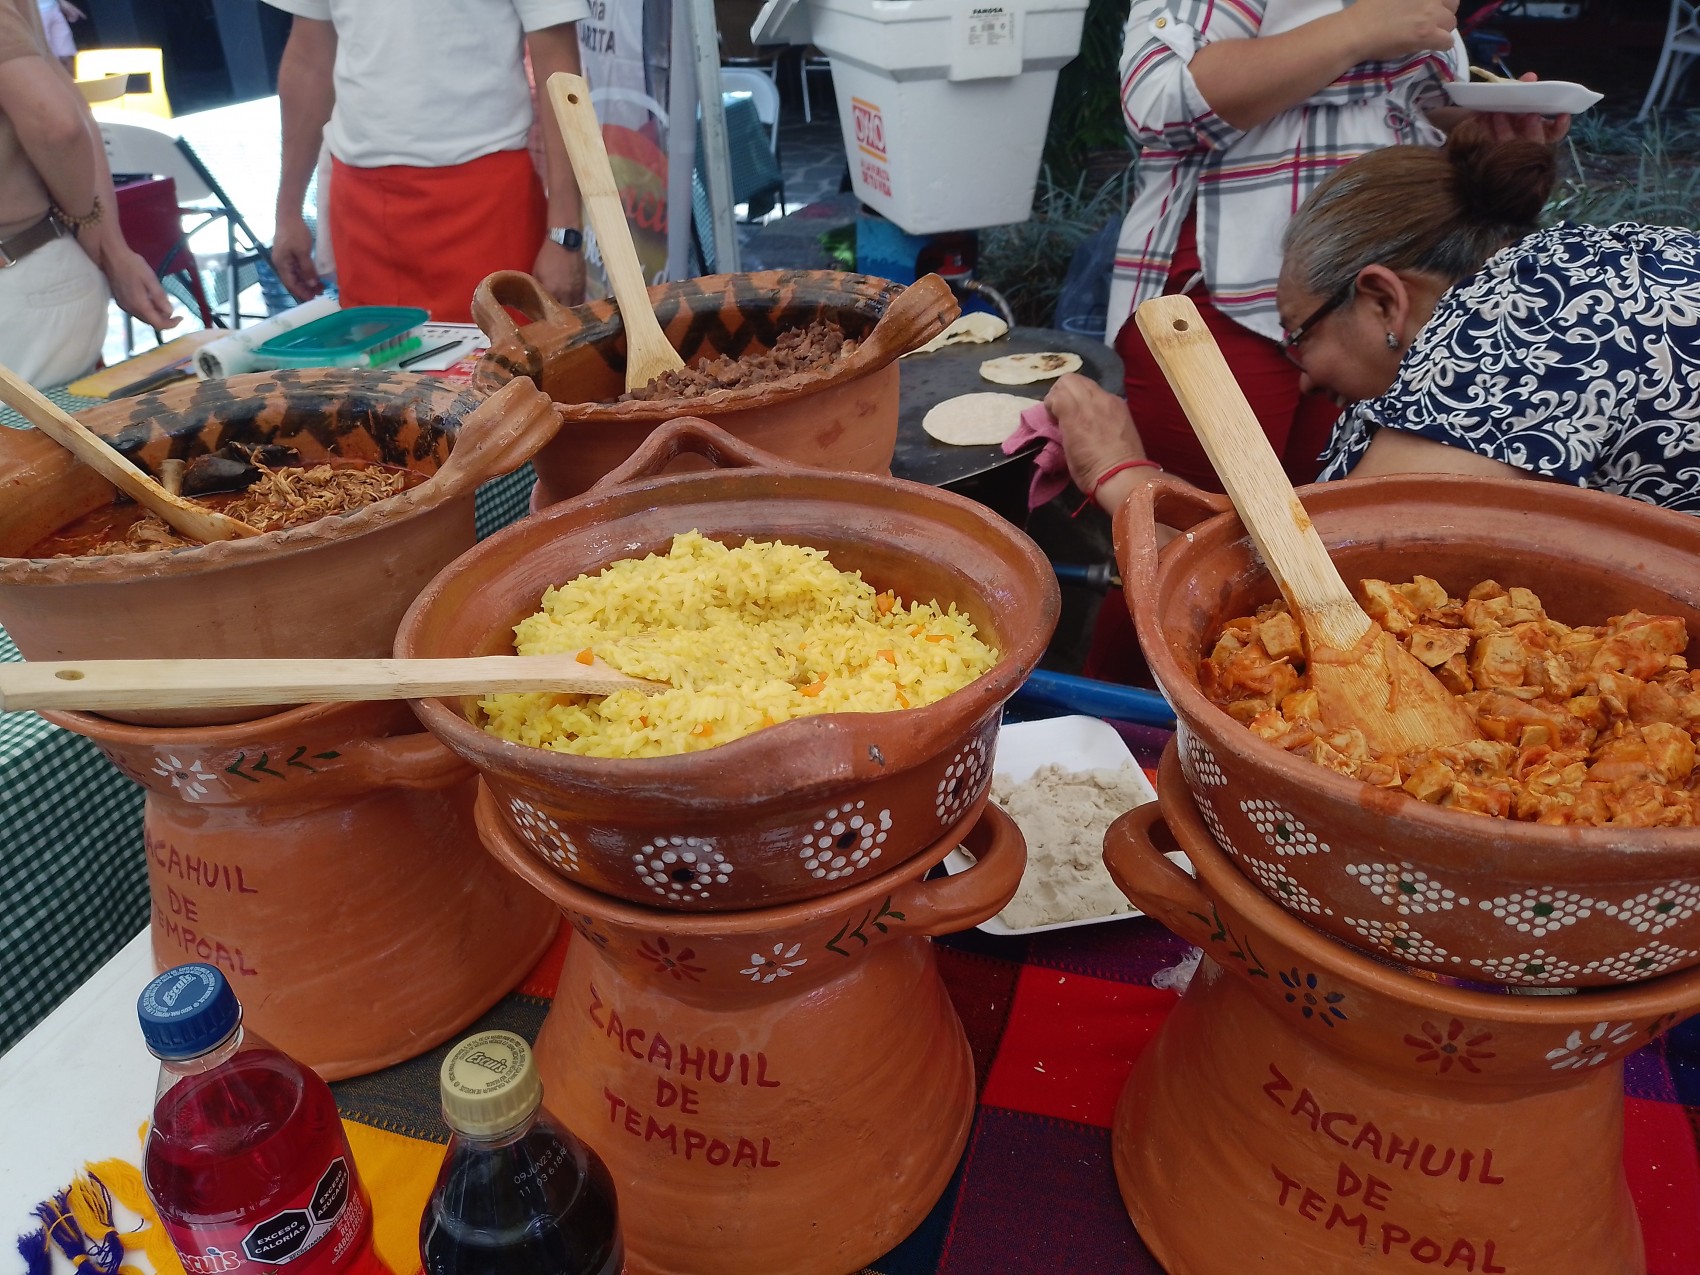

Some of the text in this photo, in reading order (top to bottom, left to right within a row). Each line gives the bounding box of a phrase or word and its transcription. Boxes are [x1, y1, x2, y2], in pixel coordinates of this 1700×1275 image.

[168, 885, 198, 923] DE
[589, 981, 780, 1088] ZACAHUIL
[656, 1076, 700, 1115] DE
[604, 1086, 781, 1168] TEMPOAL
[1262, 1062, 1505, 1185] ZACAHUIL
[319, 1170, 342, 1205] EXCESO
[1336, 1161, 1393, 1211] DE
[257, 1221, 298, 1246] EXCESO
[1271, 1163, 1506, 1274] TEMPOAL
[254, 1224, 306, 1255] CALORÍAS
[333, 1228, 354, 1256] SABOR
